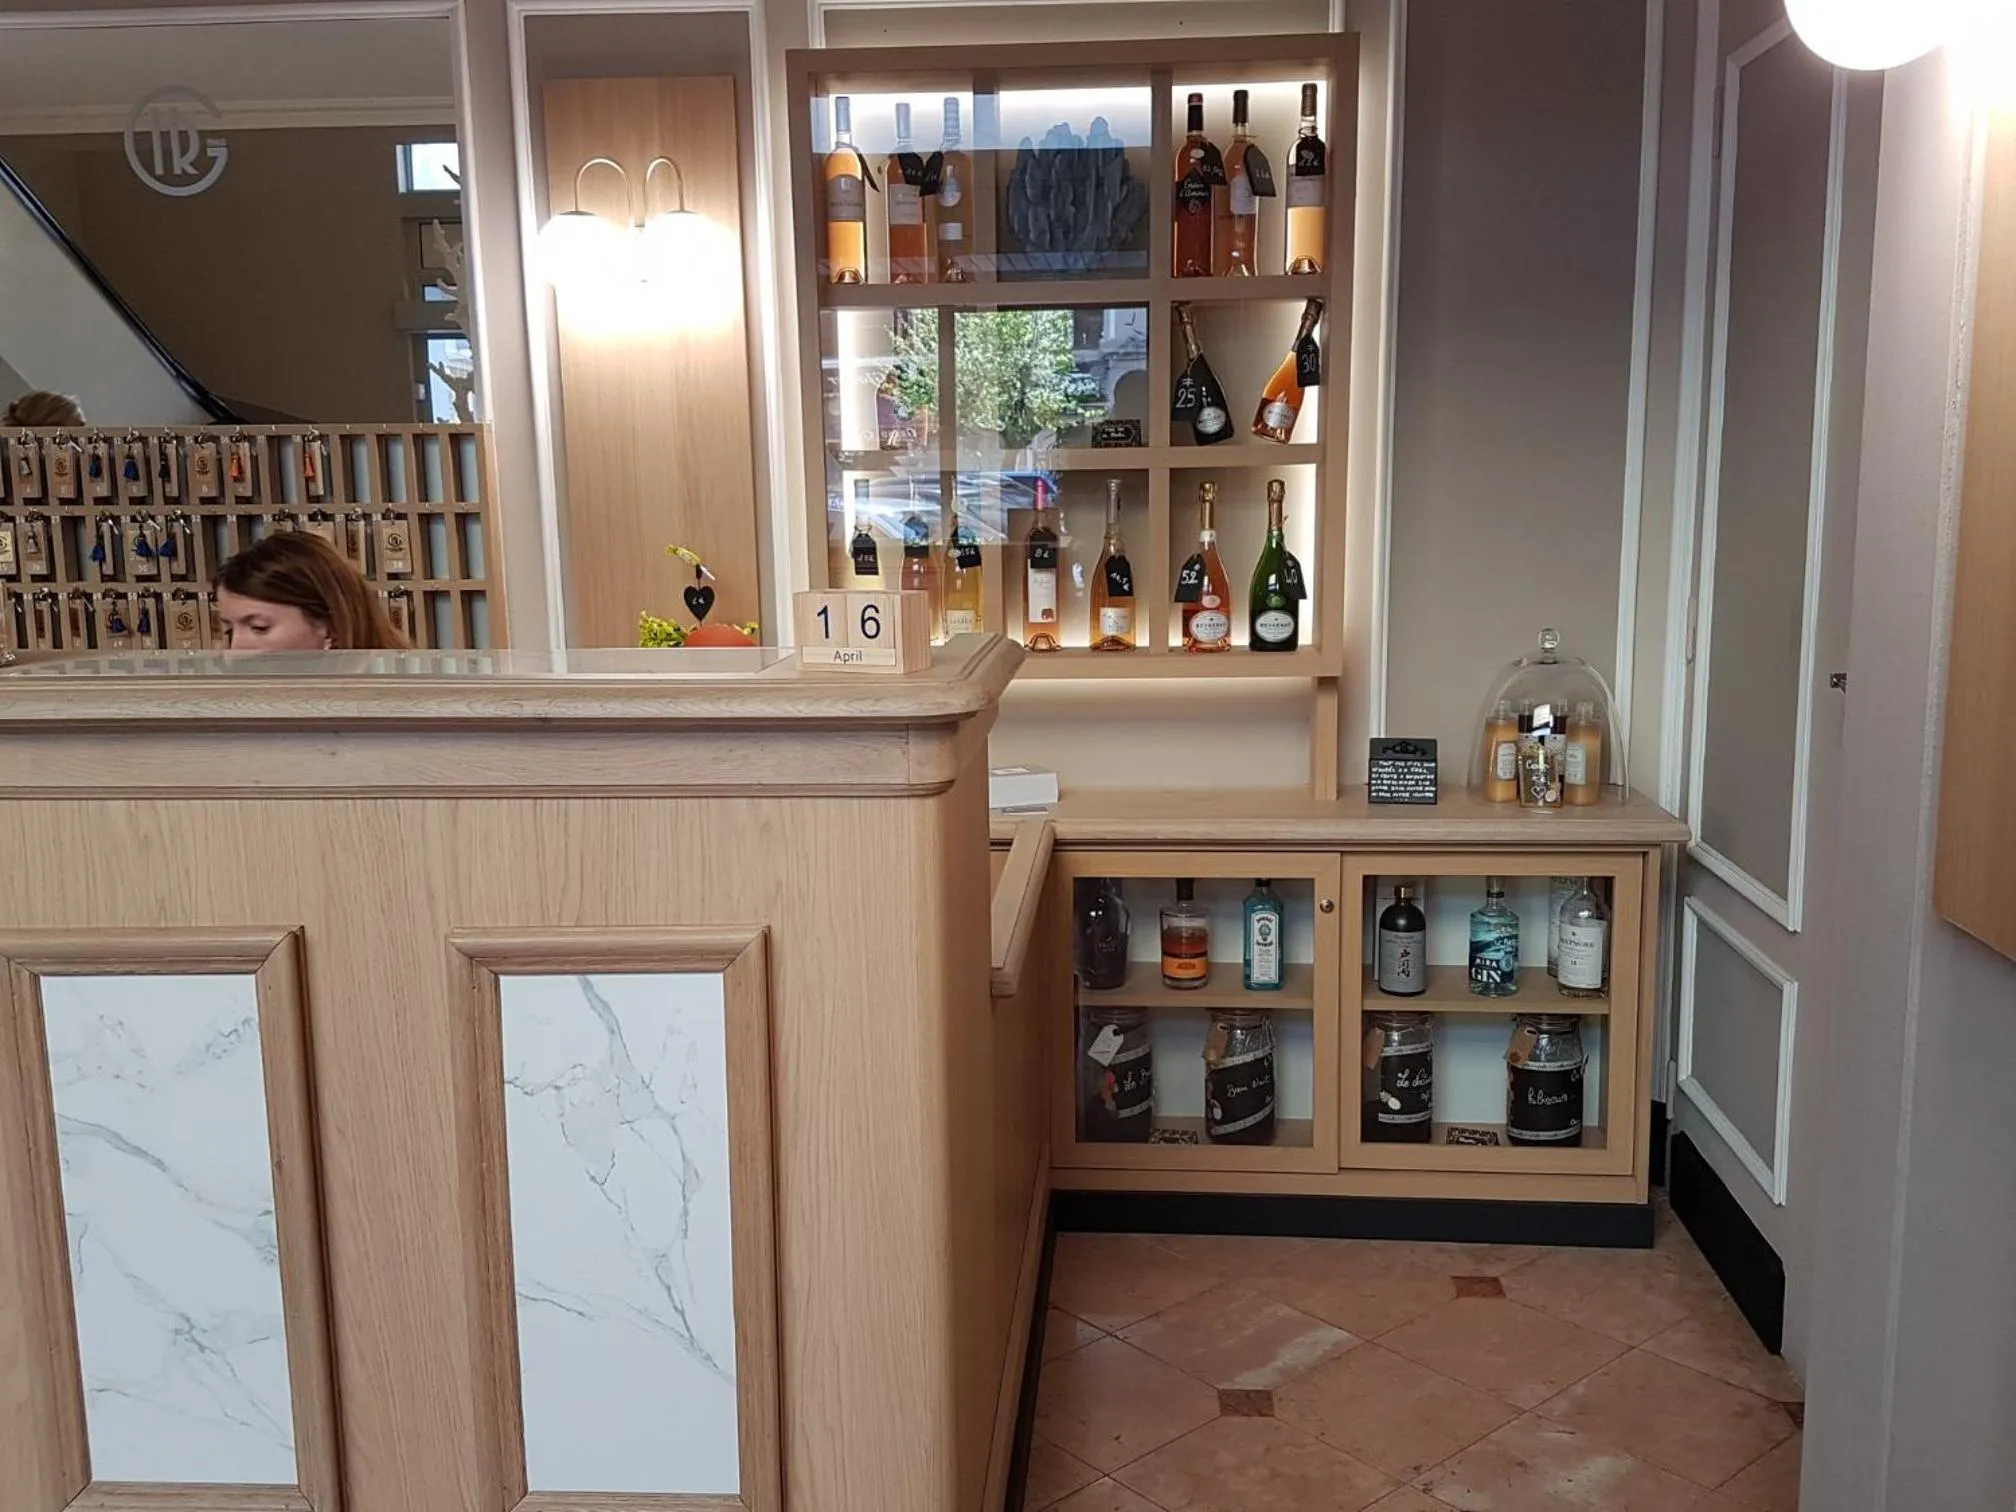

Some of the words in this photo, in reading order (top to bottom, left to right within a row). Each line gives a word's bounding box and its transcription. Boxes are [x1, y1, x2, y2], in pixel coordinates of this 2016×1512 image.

[1175, 387, 1197, 408] 25
[1180, 570, 1199, 584] 52
[816, 604, 832, 640] 1
[860, 604, 882, 639] 6
[833, 648, 864, 666] April
[1471, 967, 1503, 984] GIN
